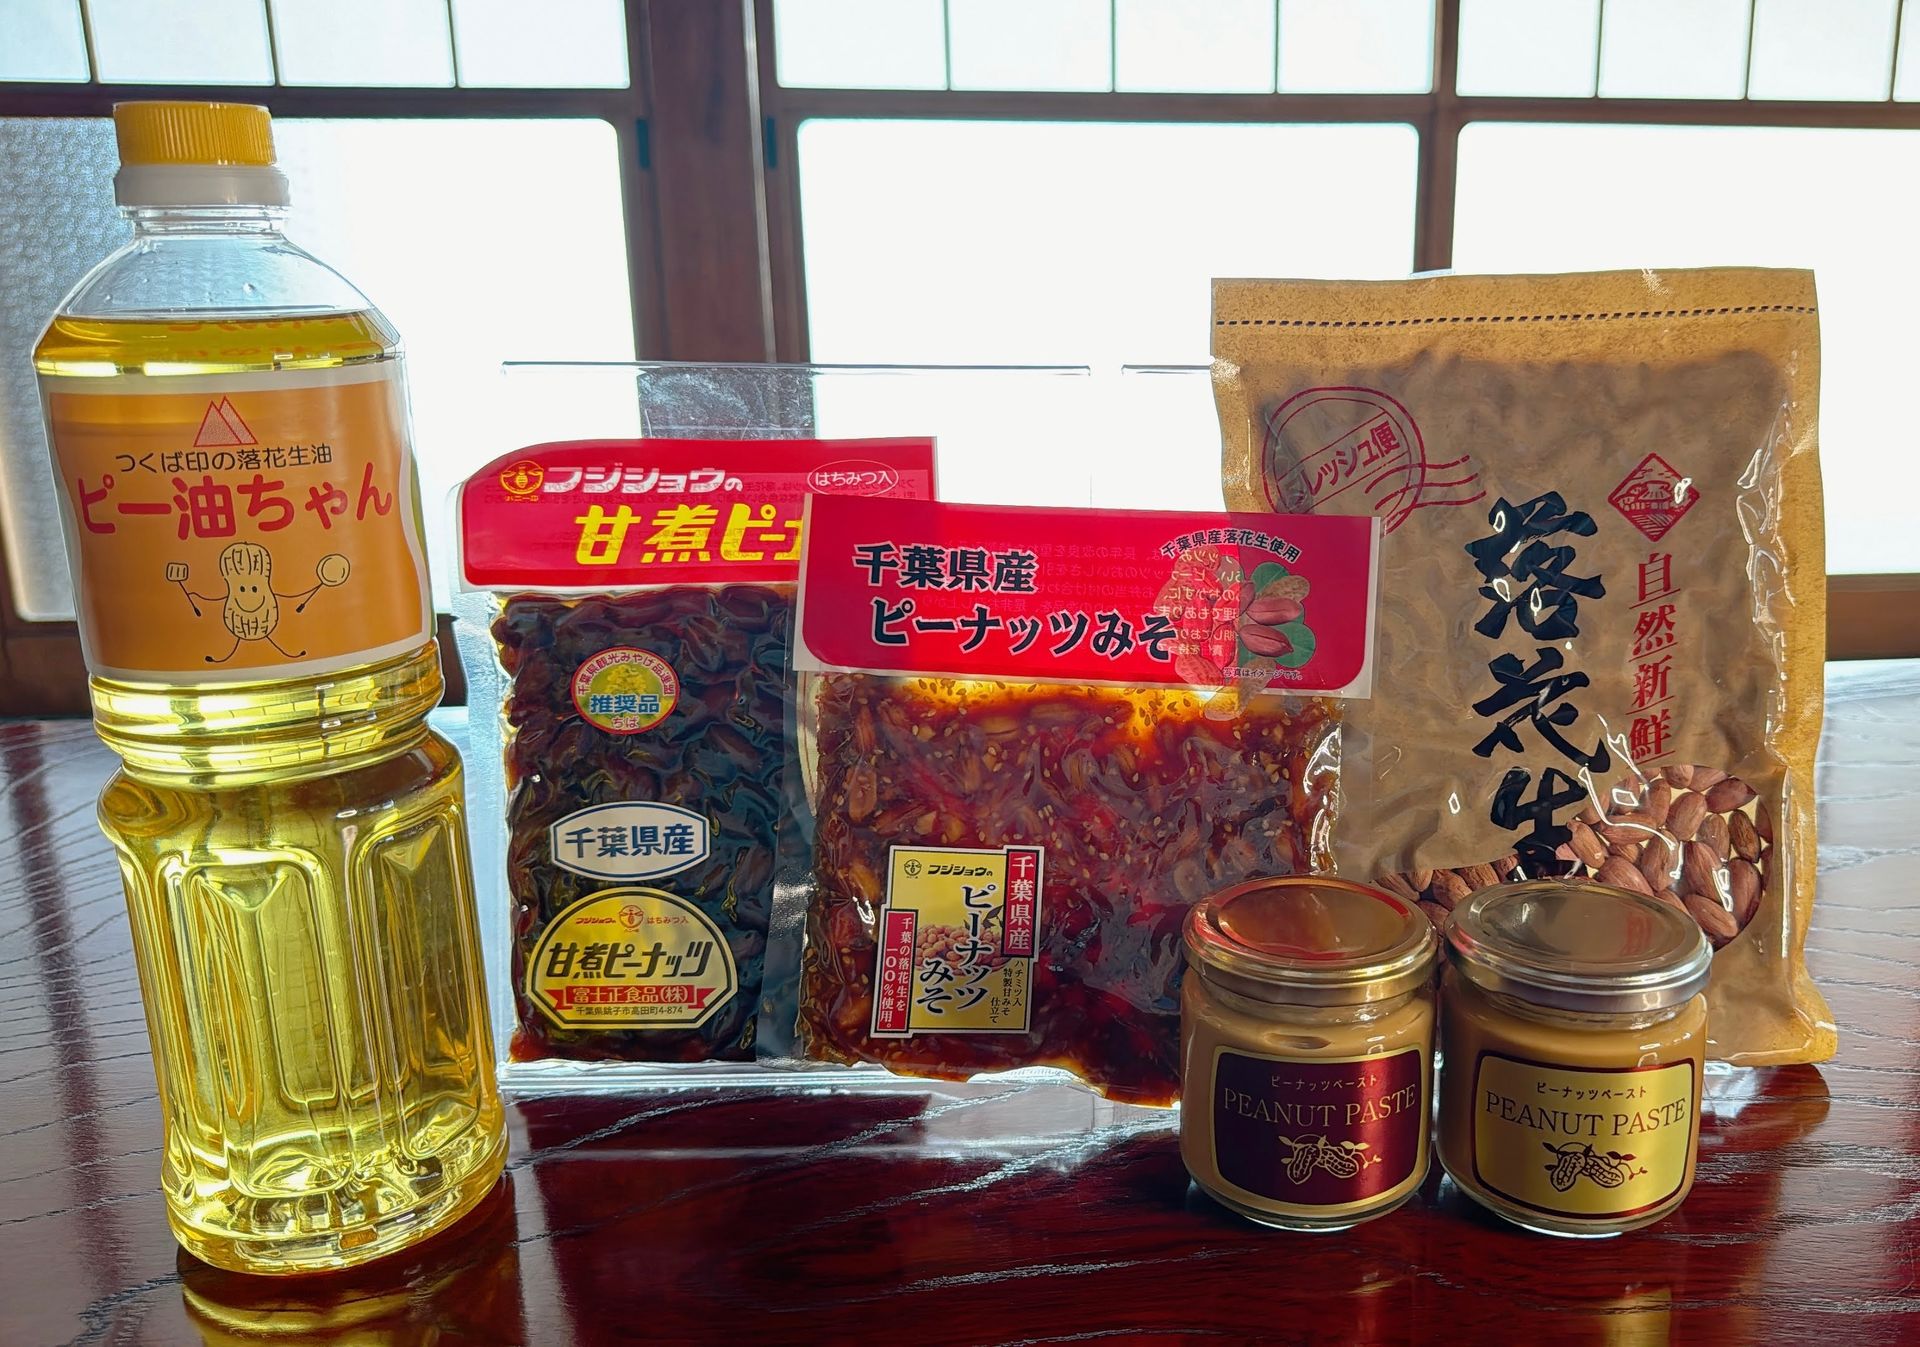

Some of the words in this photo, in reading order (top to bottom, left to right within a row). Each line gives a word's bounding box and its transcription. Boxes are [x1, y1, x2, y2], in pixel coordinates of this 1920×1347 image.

[115, 443, 333, 474] つくば印の落花生油
[543, 462, 743, 494] フジショウの
[814, 468, 894, 488] はちみつ入
[77, 461, 393, 541] ピー油ちゃん
[1160, 528, 1302, 563] 千葉県産落花生使用
[853, 541, 1038, 594] 千葉県産
[869, 597, 1178, 663] ピーナッツみそ
[1627, 552, 1679, 761] 自然新鮮
[590, 694, 660, 713] 推奨品
[1464, 491, 1611, 881] 落花生
[612, 717, 639, 729] ちば
[565, 823, 695, 859] 千葉県産
[927, 863, 993, 877] フジショウの
[1008, 855, 1035, 951] 千葉県産
[545, 941, 714, 979] 甘煮ピーナッツ
[1223, 1086, 1337, 1127] PEANUT
[1345, 1083, 1416, 1126] PASTE
[1485, 1089, 1604, 1137] PEANUT
[1611, 1097, 1686, 1137] PASTE
